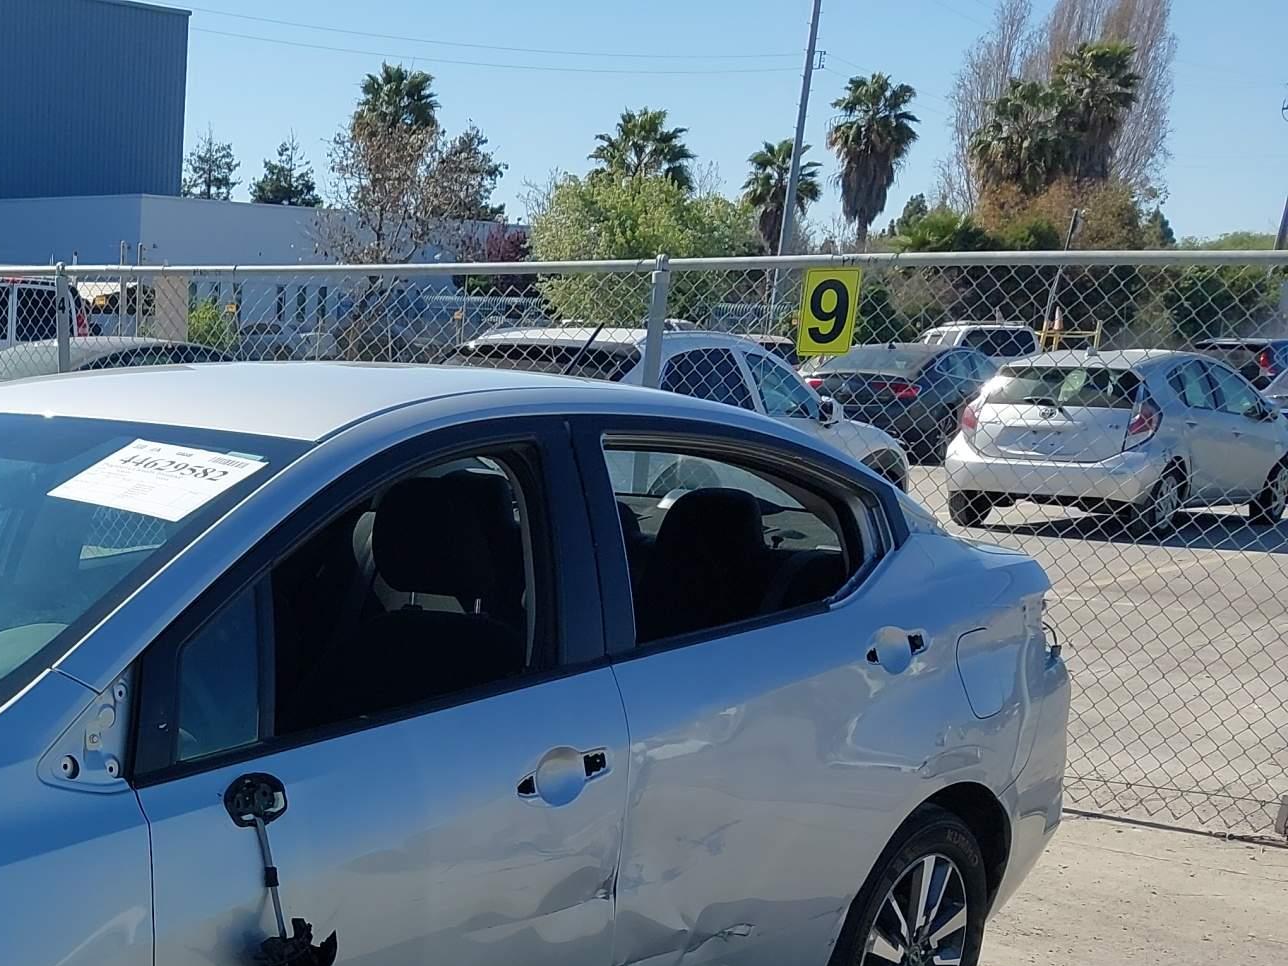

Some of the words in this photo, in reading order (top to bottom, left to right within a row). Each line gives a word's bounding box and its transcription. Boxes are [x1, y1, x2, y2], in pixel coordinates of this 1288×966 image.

[58, 297, 66, 314] 4
[808, 279, 850, 344] 9
[119, 454, 229, 482] 44629582
